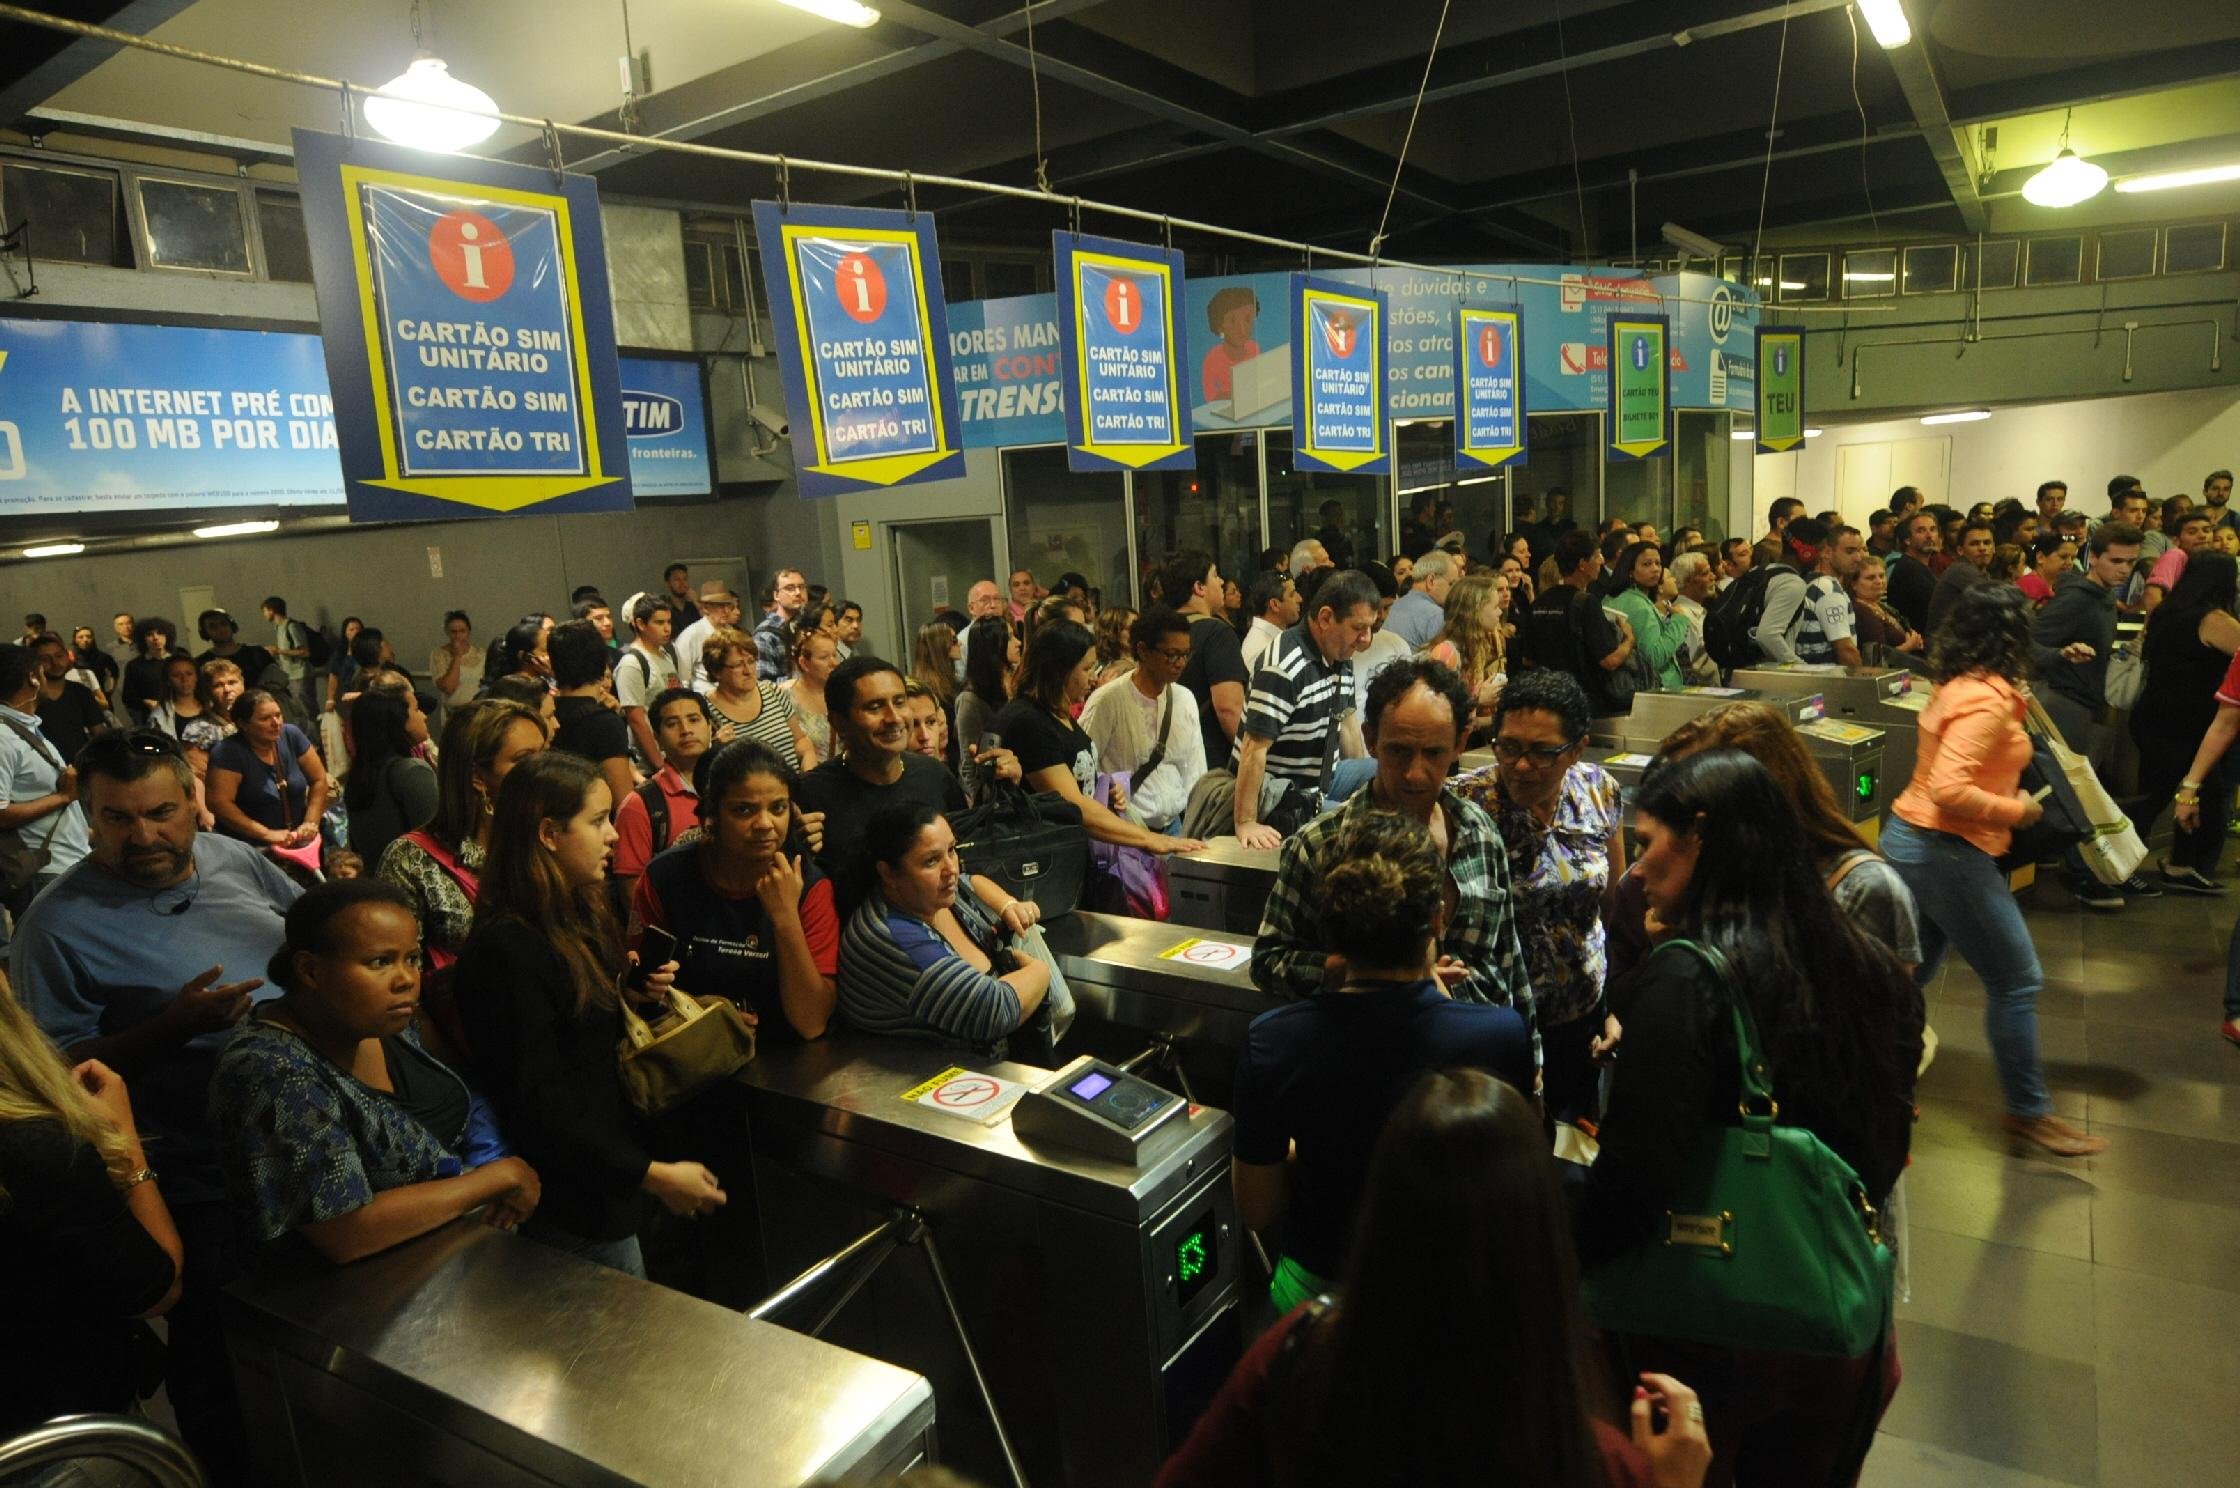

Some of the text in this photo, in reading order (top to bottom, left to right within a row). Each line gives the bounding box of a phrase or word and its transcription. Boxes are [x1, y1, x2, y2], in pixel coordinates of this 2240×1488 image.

[1402, 276, 1471, 296] dúvidas
[1477, 281, 1487, 294] e
[1390, 307, 1440, 326] stões,
[398, 320, 562, 351] CARTÃO SIM
[1014, 321, 1059, 350] MAN
[1388, 335, 1453, 352] ios atra
[820, 338, 918, 359] CARTÃO SIM
[1090, 346, 1162, 365] CARTÃO SIM
[419, 346, 549, 374] UNITÁRIO
[834, 355, 910, 378] UNITÁRIO
[954, 352, 1061, 383] AR EM CON
[1099, 360, 1156, 379] UNITÁRIO
[1316, 367, 1370, 383] CARTÃO SIM
[1389, 365, 1453, 380] os can
[1321, 381, 1365, 396] UNITÁRIO
[1471, 376, 1512, 389] CARTÃO SIM
[1623, 386, 1646, 398] CARTÃO
[61, 388, 82, 413] A
[88, 388, 222, 415] INTERNET
[231, 389, 282, 417] PRÉ
[408, 385, 568, 413] CARTÃO SIM
[829, 387, 924, 410] CARTÃO SIM
[961, 381, 1064, 422] TRENS
[1093, 386, 1164, 404] CARTÃO SIM
[1475, 388, 1508, 400] UNITÁRIO
[1767, 392, 1794, 414] TEU
[622, 401, 670, 428] TIM
[1317, 402, 1371, 417] CARTÃO SIM
[1472, 405, 1512, 418] CARTÃO SIM
[834, 417, 927, 442] CARTÃO TRI
[1097, 413, 1165, 429] CARTÃO TRI
[64, 417, 339, 449] 100 MB POR DIA
[416, 427, 571, 453] CARTÃO TRI
[1319, 424, 1371, 438] CARTÃO TRI
[1472, 425, 1512, 437] CARTÃO TRI
[632, 447, 697, 458] fronteiras.
